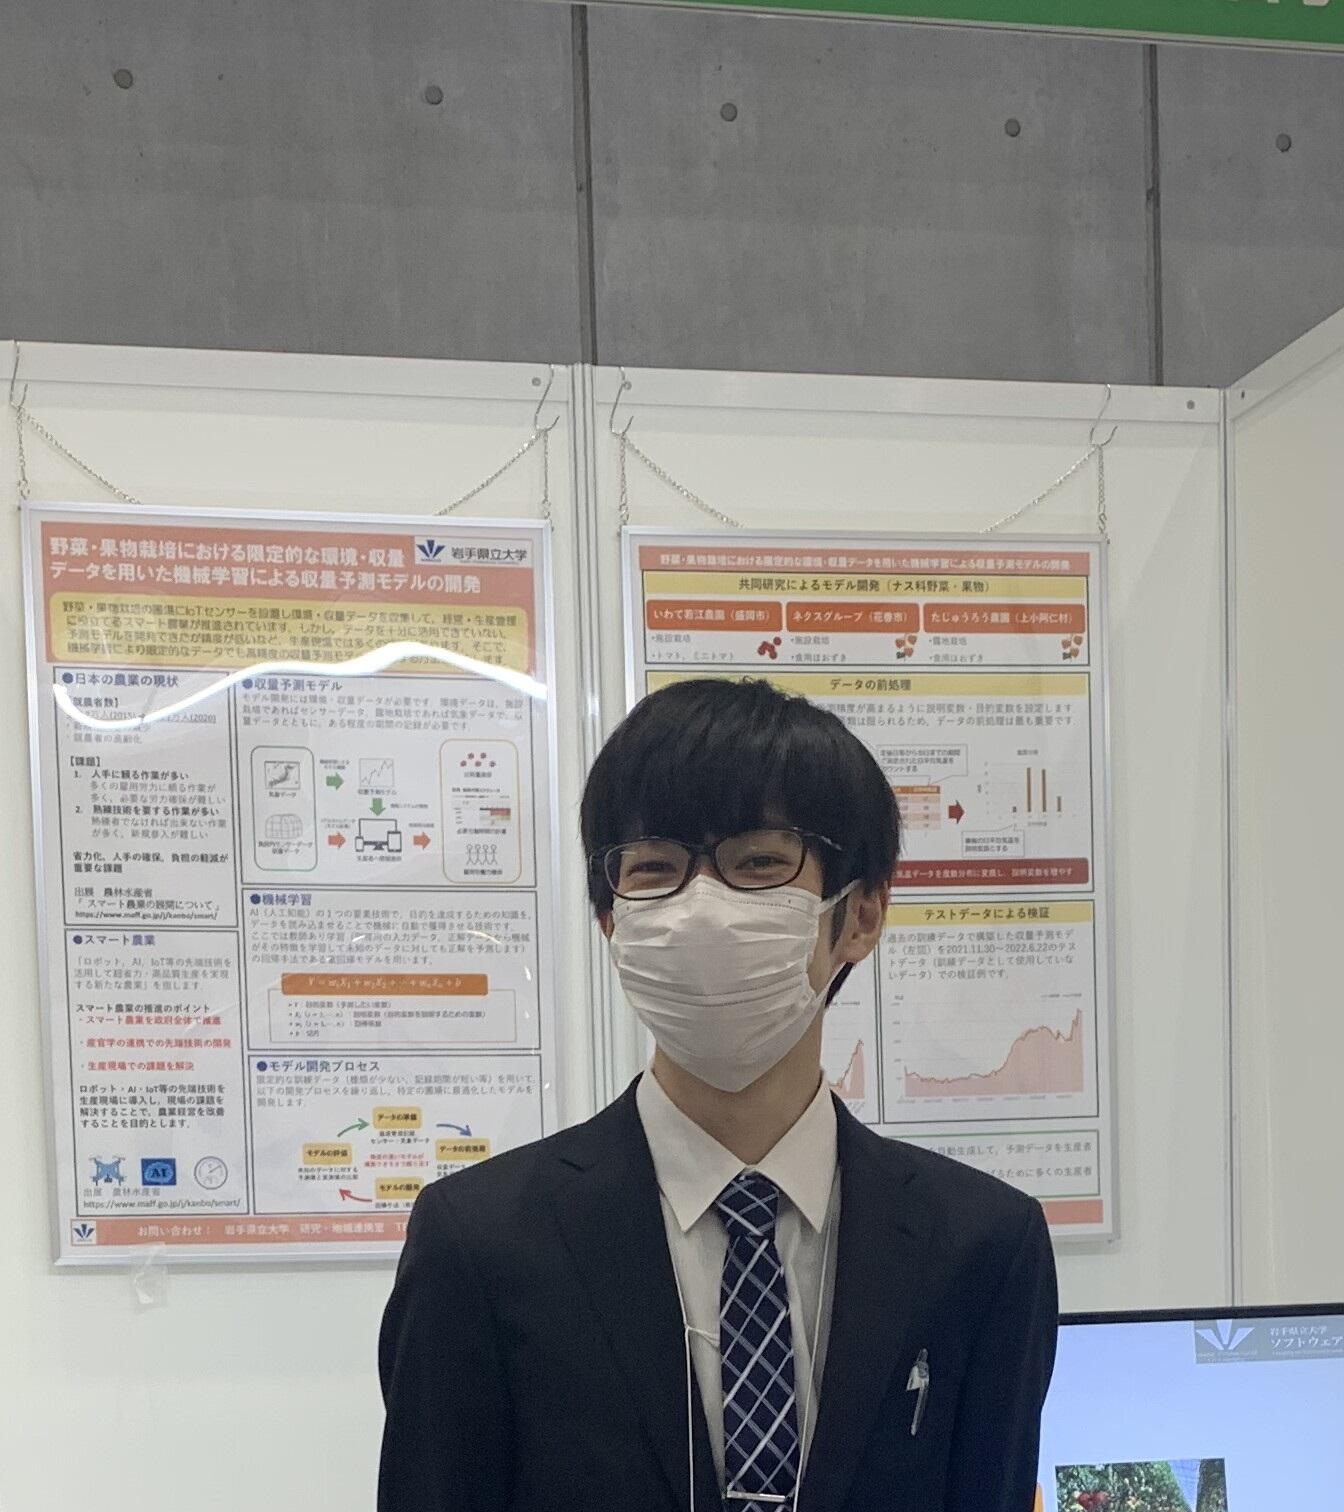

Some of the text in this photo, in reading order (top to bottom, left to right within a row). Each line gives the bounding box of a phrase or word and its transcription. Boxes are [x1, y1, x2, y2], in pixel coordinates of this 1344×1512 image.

[50, 536, 405, 568] 野菜・果物栽培における限定的な環境・収量
[451, 546, 529, 562] 岩手県立大学
[51, 561, 482, 594] データを用いた機械学習による収量予測モデルの開発
[75, 672, 180, 688] 日本の農業の現状
[254, 678, 344, 692] 収量予測モデル
[829, 678, 912, 692] データの前処理
[69, 755, 102, 768] 【課題】
[91, 769, 190, 781] 人手に頼る作業が多い
[92, 804, 221, 817] 熟練技術を要する作業が多い
[73, 863, 123, 873] 重要な課題
[103, 886, 154, 898] 農林水産省
[262, 893, 312, 906] 機械学習
[924, 906, 1051, 921] テストデータによる検証
[84, 933, 156, 946] スマート農業
[75, 1003, 210, 1014] スマート農業の推進のポイント
[268, 1059, 381, 1073] モデル開発プロセス
[150, 1168, 168, 1178] AI
